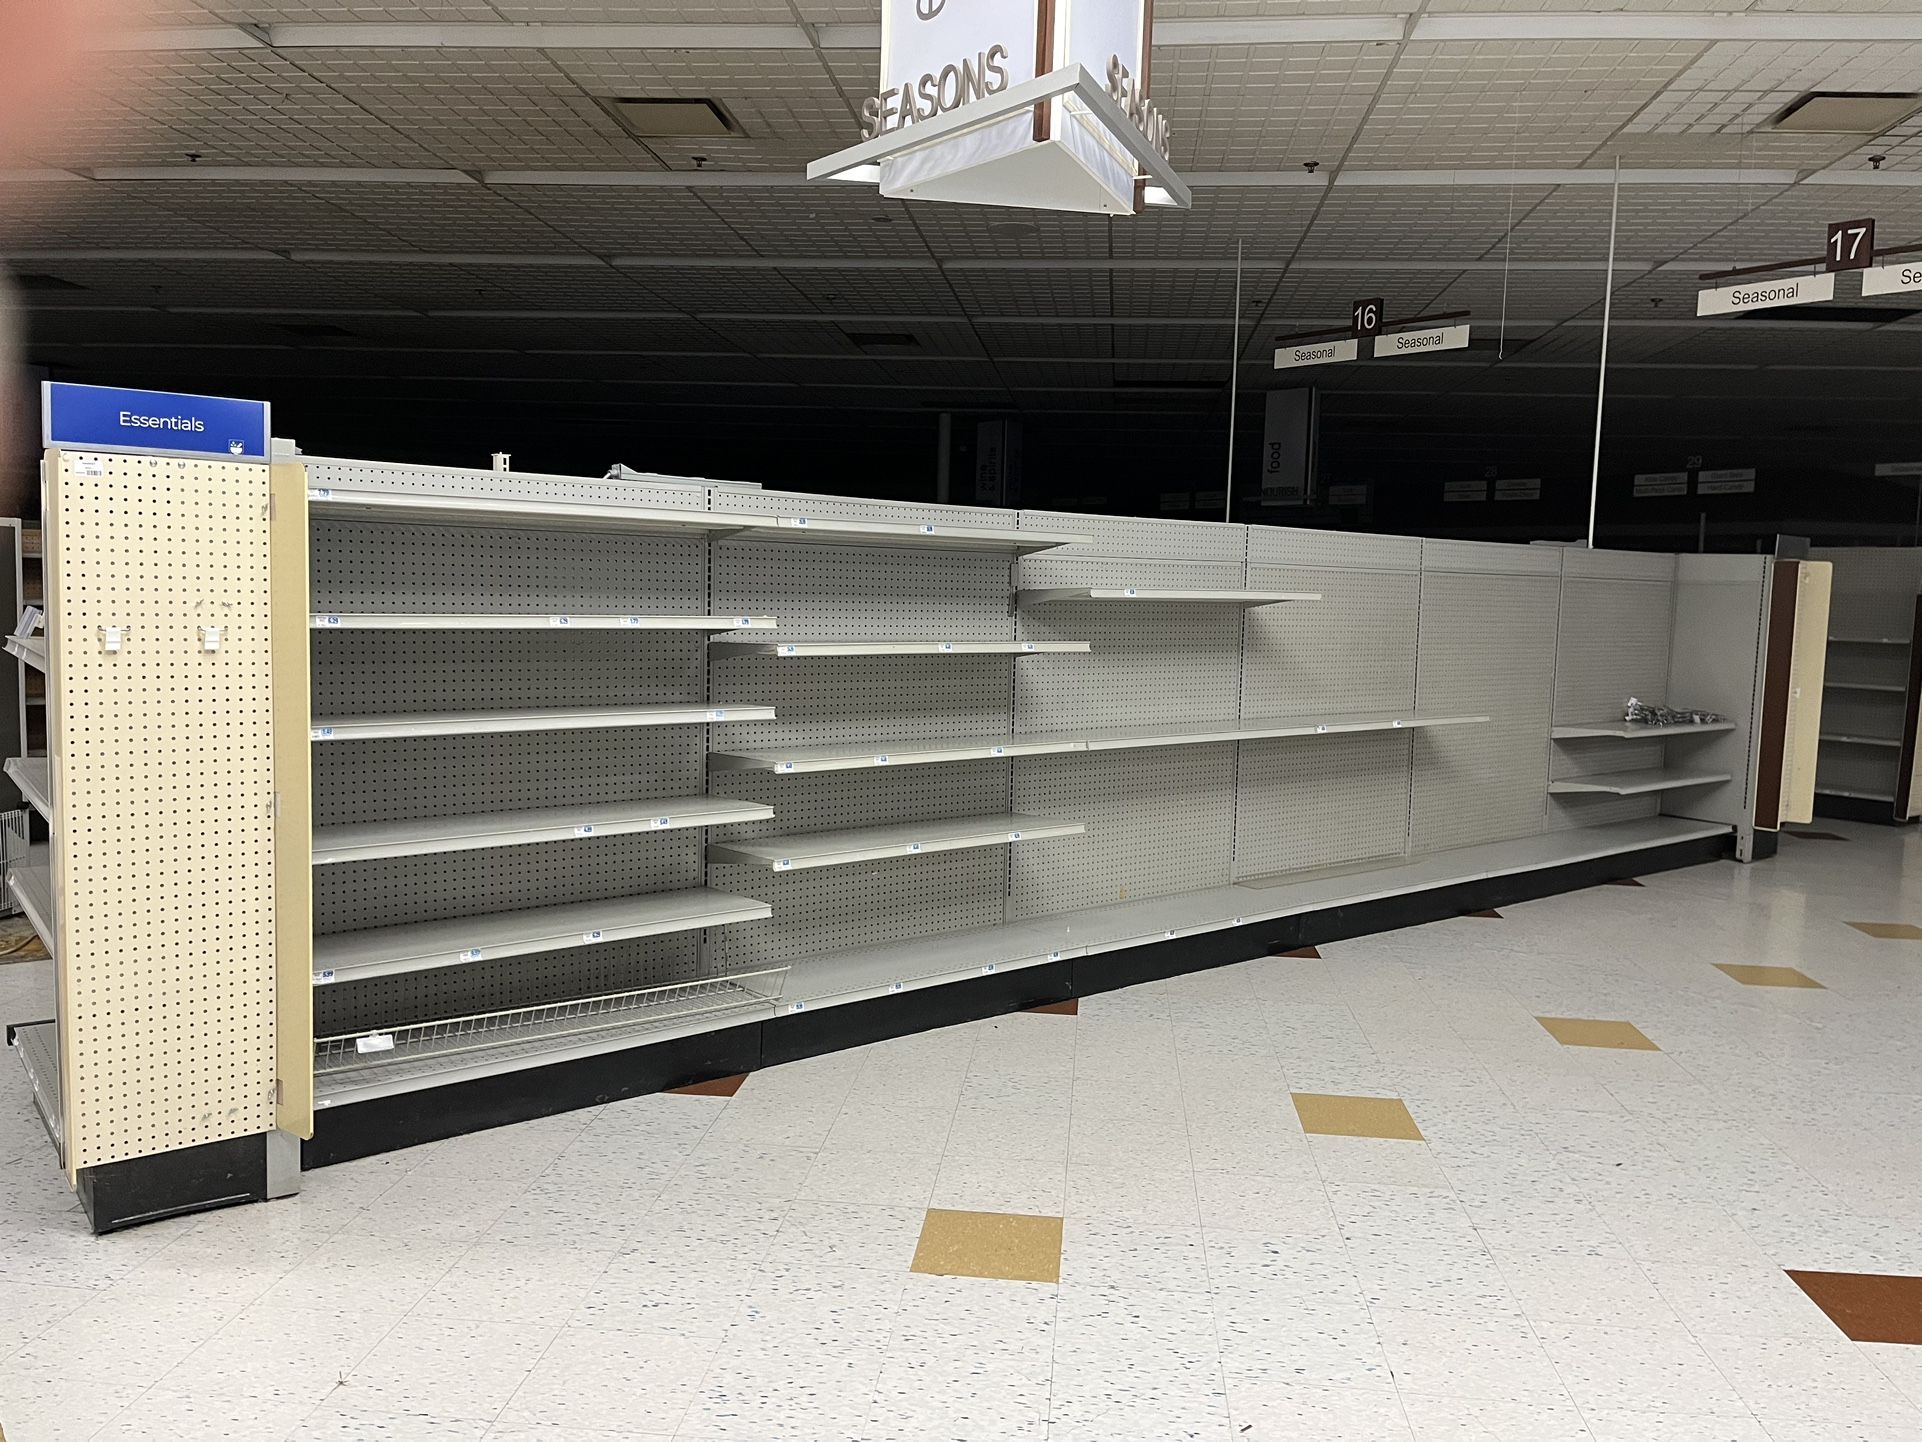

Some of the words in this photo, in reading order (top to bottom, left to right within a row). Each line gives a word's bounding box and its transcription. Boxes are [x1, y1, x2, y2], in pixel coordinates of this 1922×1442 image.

[861, 44, 1009, 142] SEASONS
[1105, 54, 1171, 161] SEASONS
[1830, 227, 1867, 262] 17
[1731, 283, 1799, 306] Seasonal
[1353, 304, 1377, 331] 16
[1396, 332, 1444, 350] Seasonal
[1294, 346, 1336, 362] Seasonal
[119, 411, 205, 432] Essentials
[1267, 441, 1282, 474] food
[1687, 456, 1702, 468] 29
